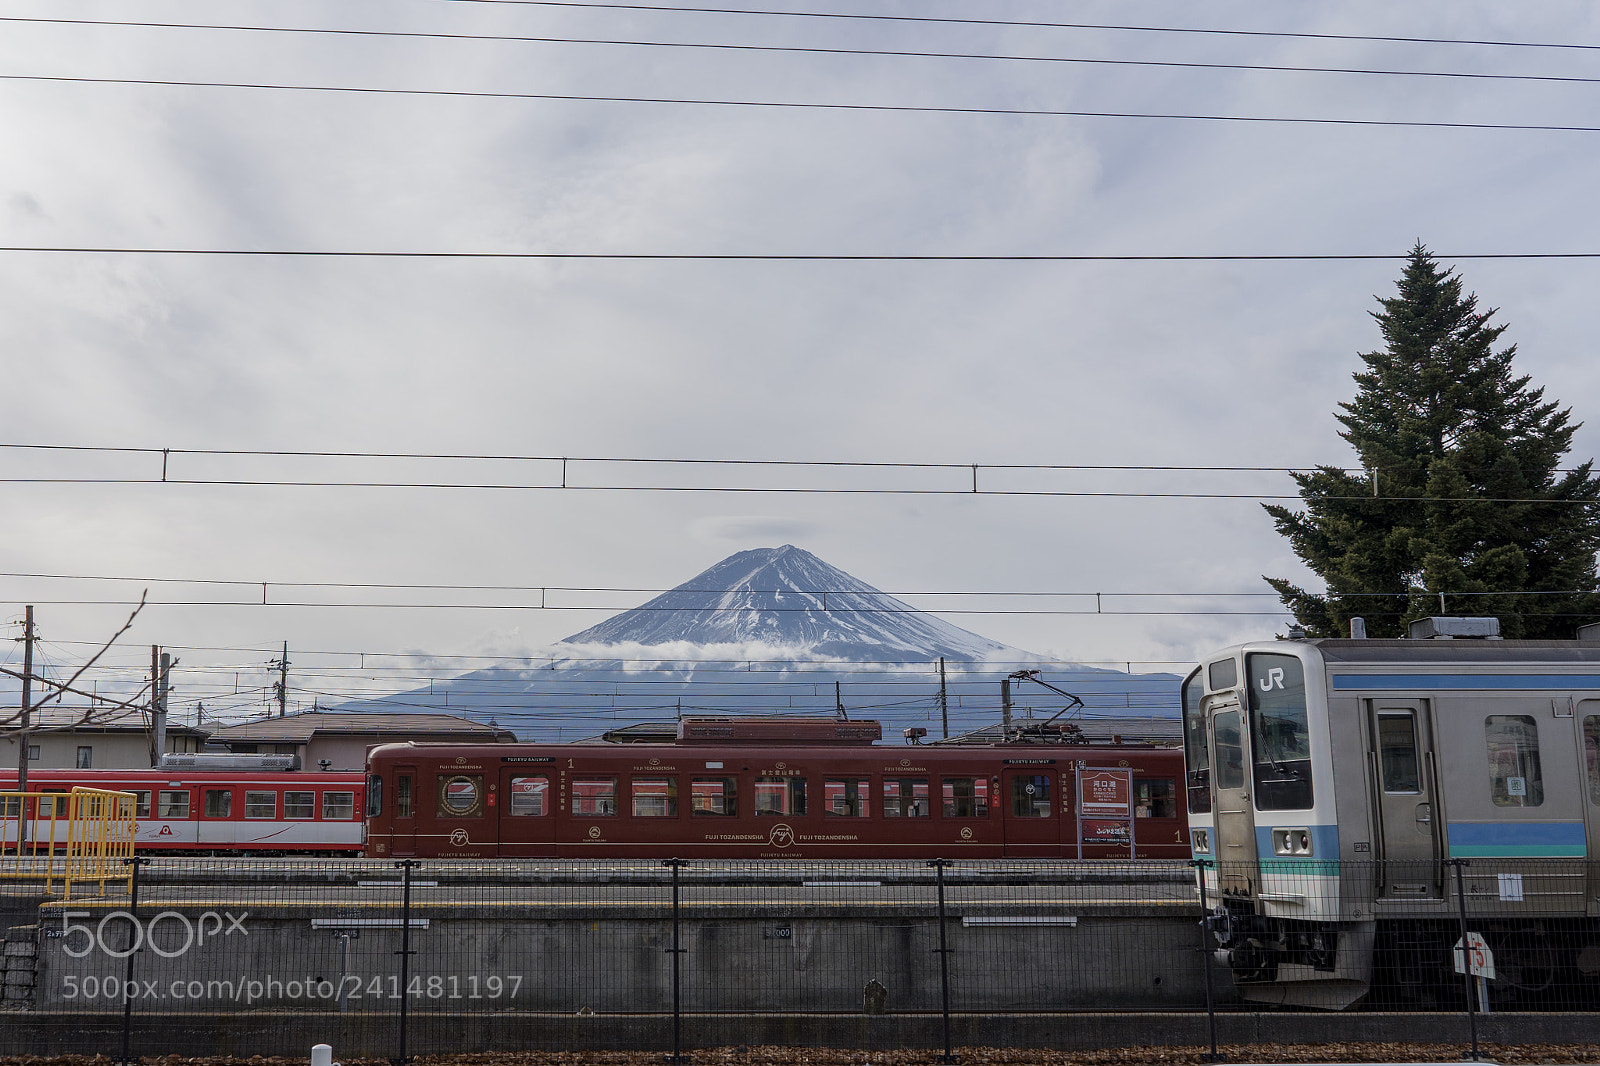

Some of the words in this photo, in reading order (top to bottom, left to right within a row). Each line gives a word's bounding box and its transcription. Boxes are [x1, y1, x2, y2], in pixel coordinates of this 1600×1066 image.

[1260, 667, 1284, 692] JR
[567, 758, 575, 769] 1
[1174, 829, 1183, 843] 1
